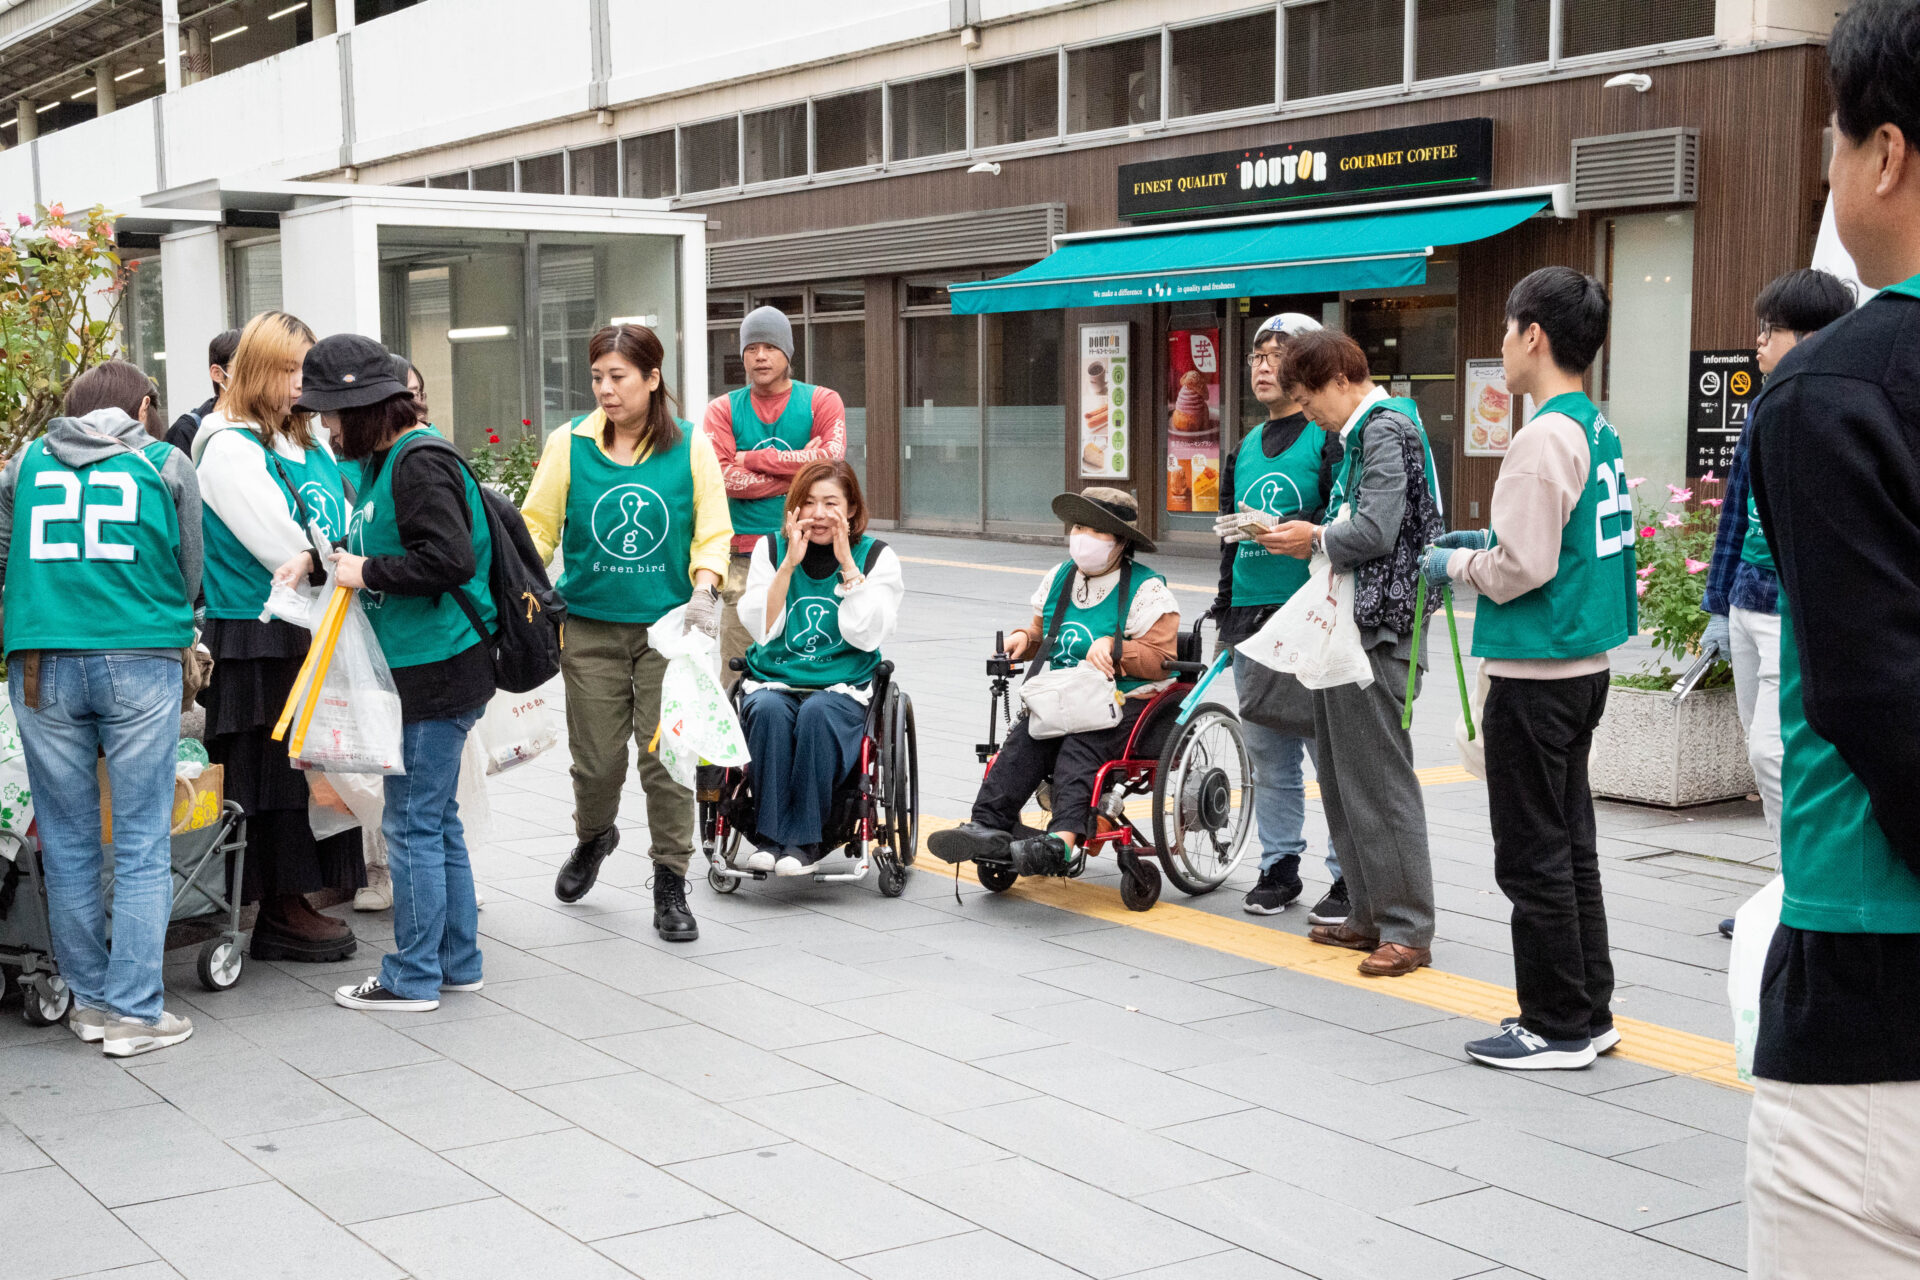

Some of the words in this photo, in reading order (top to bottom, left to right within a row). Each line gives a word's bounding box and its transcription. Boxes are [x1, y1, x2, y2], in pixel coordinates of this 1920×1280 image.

[1134, 178, 1172, 195] FINEST
[1178, 172, 1228, 192] QUALITY
[1239, 149, 1327, 190] DOUTOR
[1340, 150, 1403, 171] GOURMET
[1407, 144, 1458, 163] COFFEE
[1118, 288, 1143, 297] difference
[1177, 285, 1182, 293] in
[1183, 285, 1201, 294] quality
[1202, 283, 1211, 291] and
[1212, 282, 1236, 290] freshness
[1703, 355, 1749, 364] information
[1731, 403, 1748, 419] 71
[30, 471, 141, 564] 22
[1240, 547, 1268, 559] green
[593, 561, 634, 573] green
[637, 563, 666, 573] bird
[512, 698, 545, 718] green
